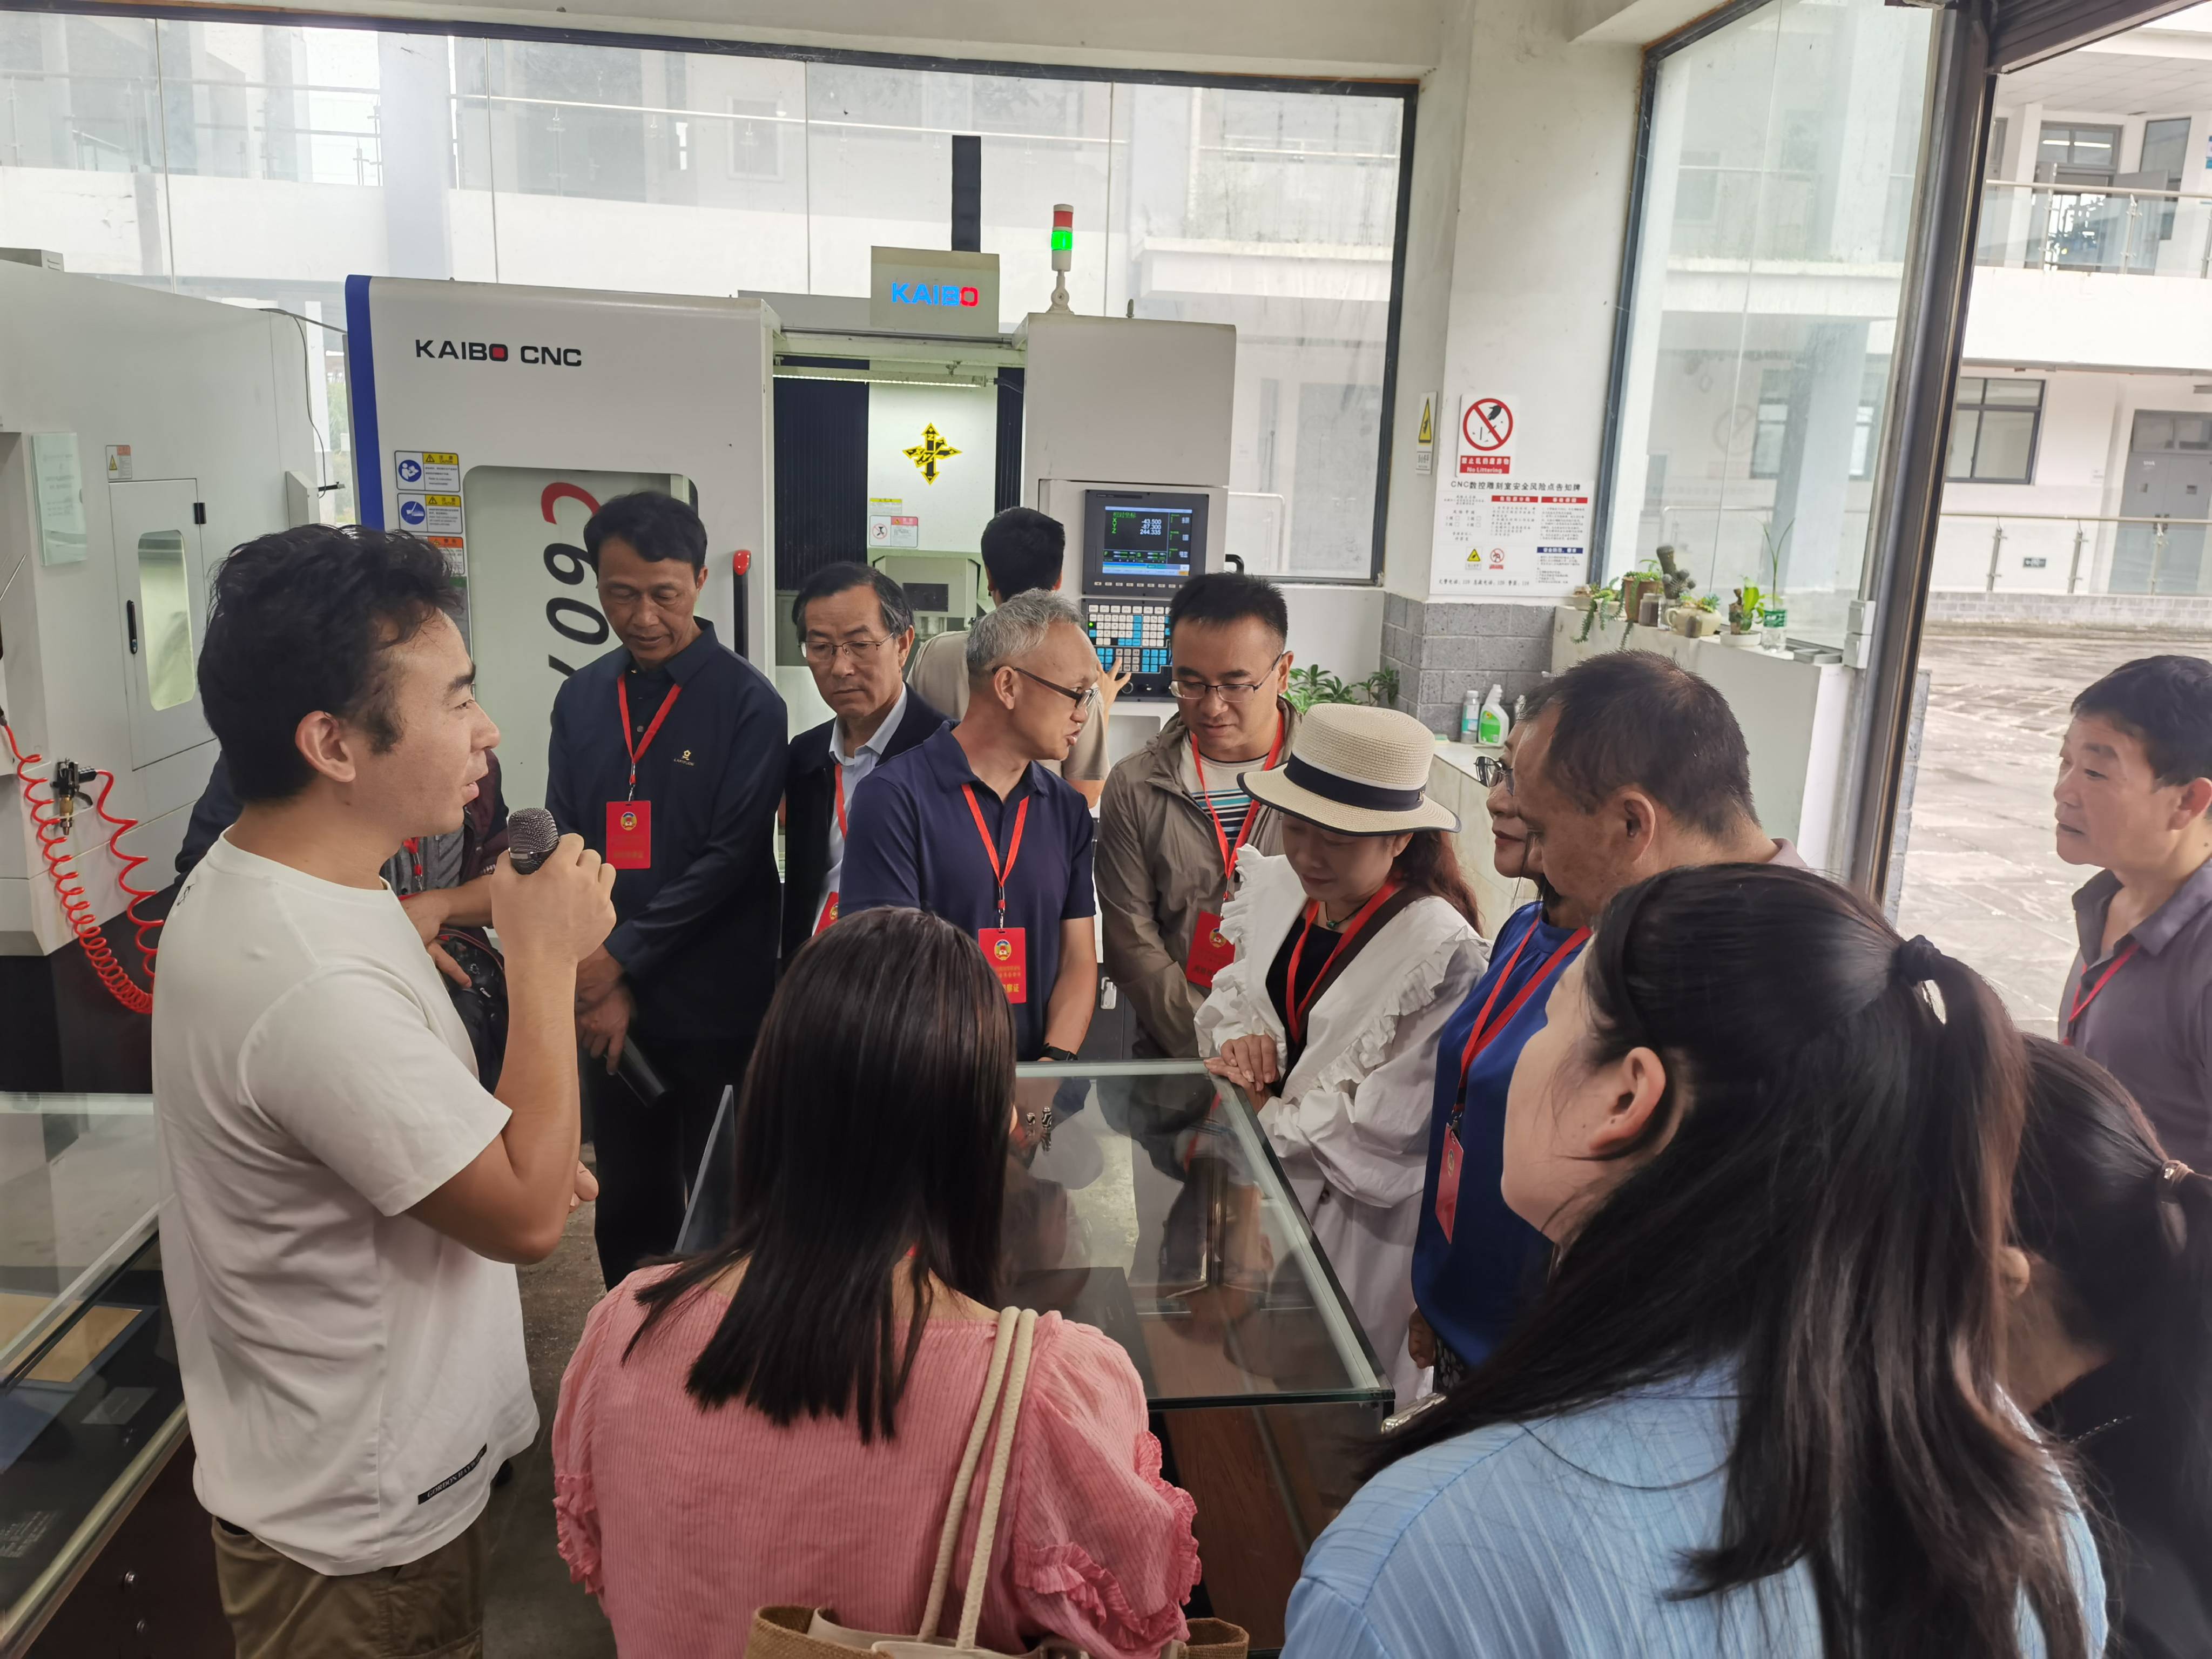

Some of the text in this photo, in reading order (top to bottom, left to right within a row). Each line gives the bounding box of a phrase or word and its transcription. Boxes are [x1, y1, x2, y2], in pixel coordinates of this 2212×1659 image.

[892, 282, 979, 307] KAIBO
[415, 339, 582, 367] KAIBO CNC
